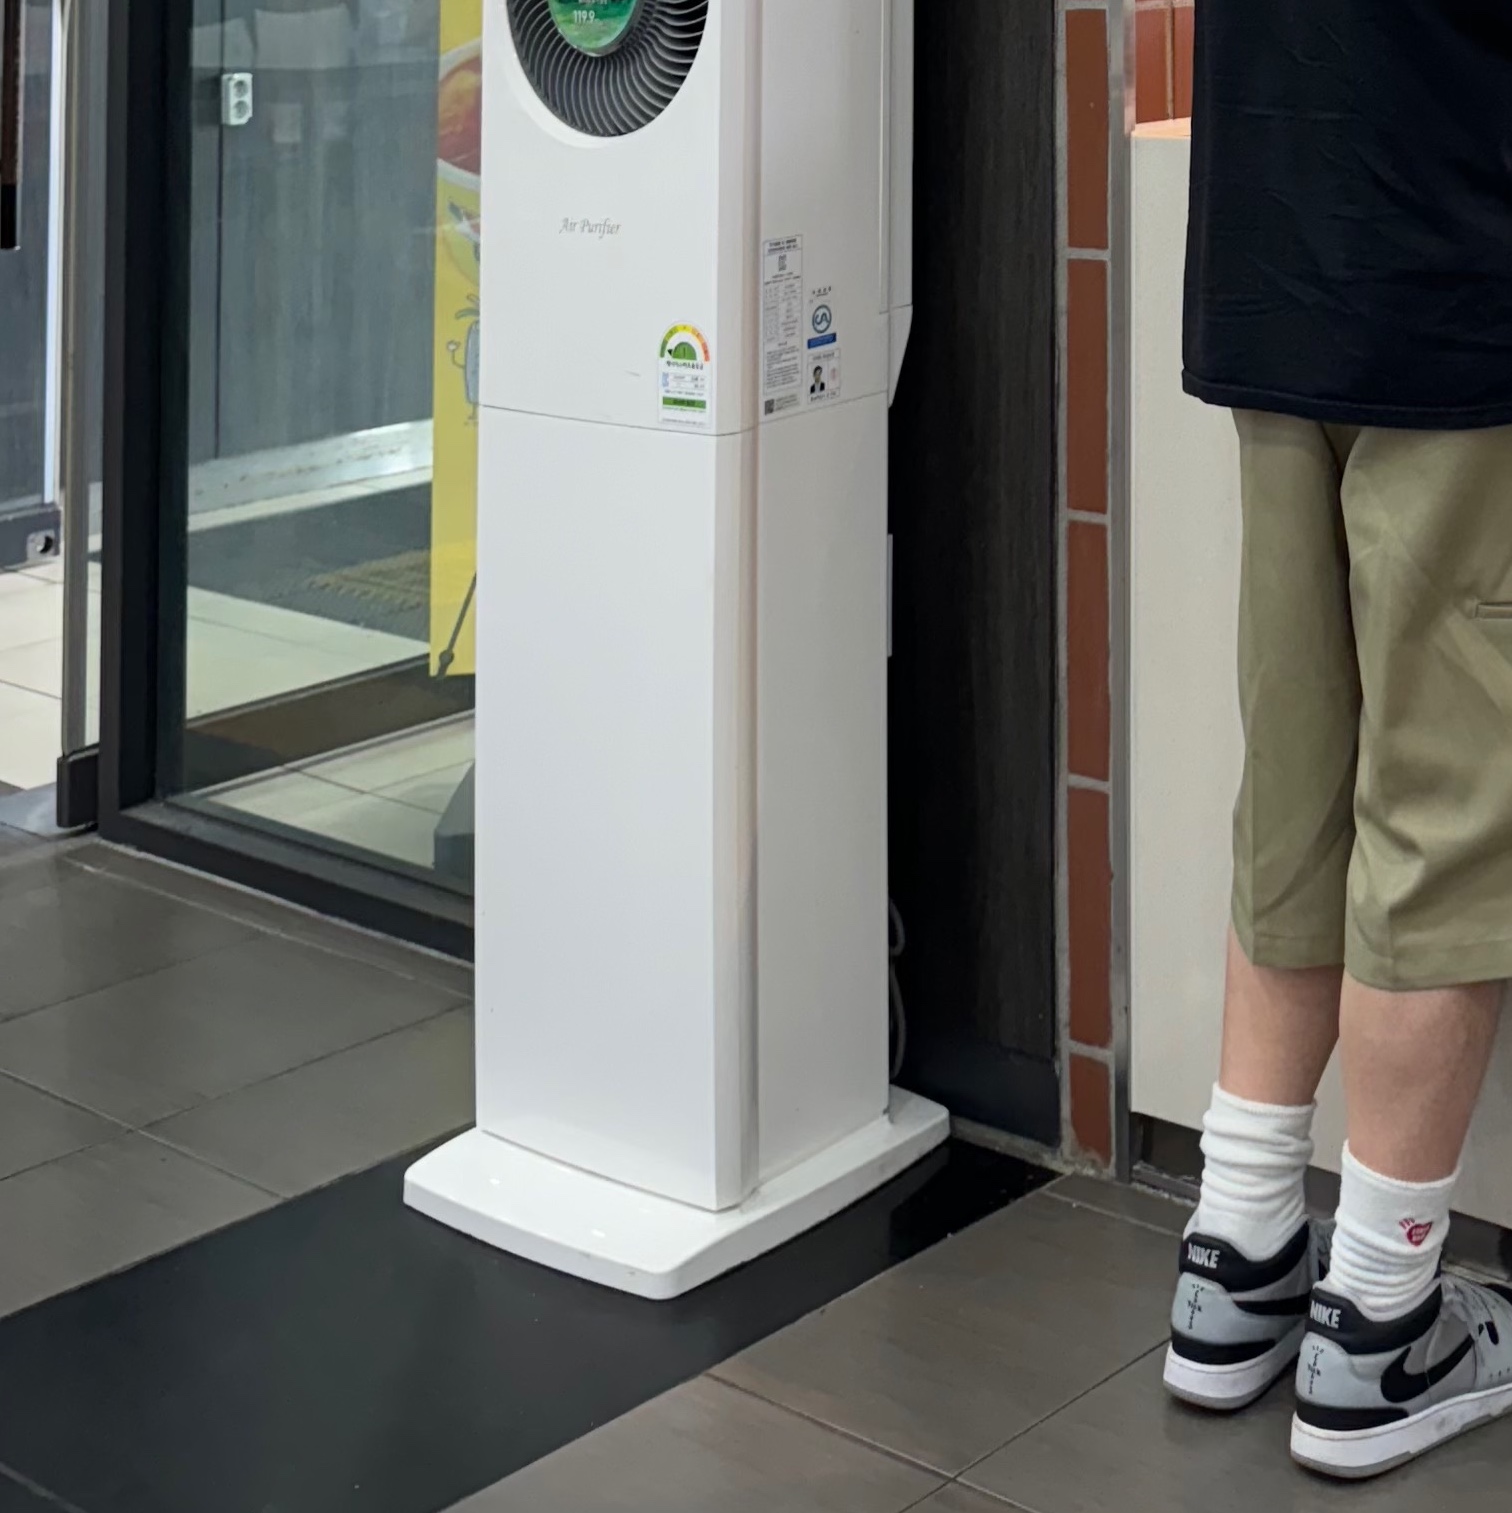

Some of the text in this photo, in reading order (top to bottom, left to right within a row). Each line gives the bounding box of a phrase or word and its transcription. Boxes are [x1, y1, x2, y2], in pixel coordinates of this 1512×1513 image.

[559, 217, 622, 239] Air Purifier
[1187, 1242, 1221, 1269] NIKE
[1309, 1300, 1342, 1330] NIKE
